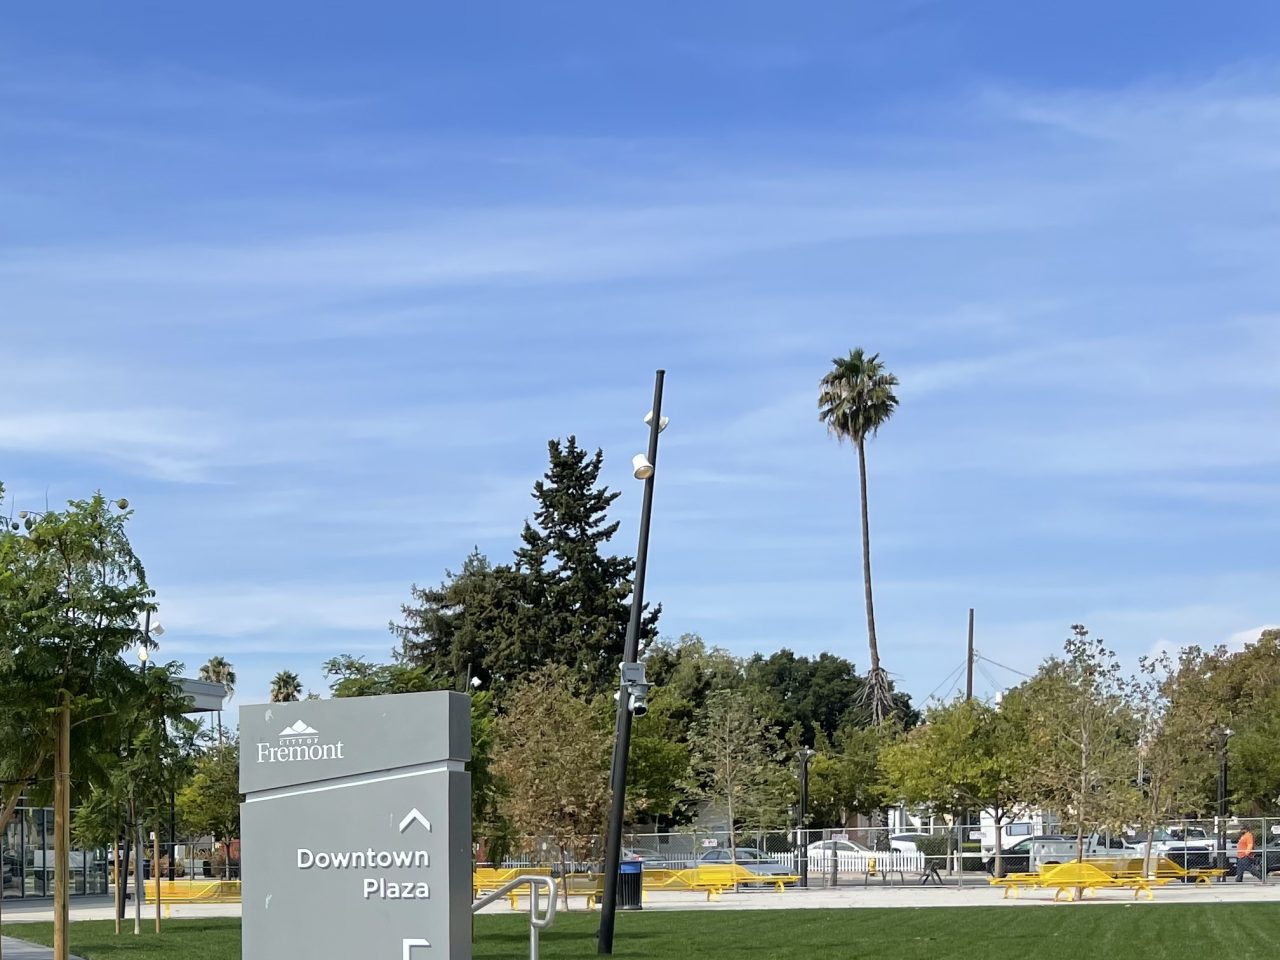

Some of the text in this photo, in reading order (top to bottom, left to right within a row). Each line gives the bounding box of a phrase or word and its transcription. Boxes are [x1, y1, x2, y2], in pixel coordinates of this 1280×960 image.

[256, 740, 345, 763] Fremont
[297, 848, 429, 868] Downtown
[363, 877, 429, 898] Plaza
